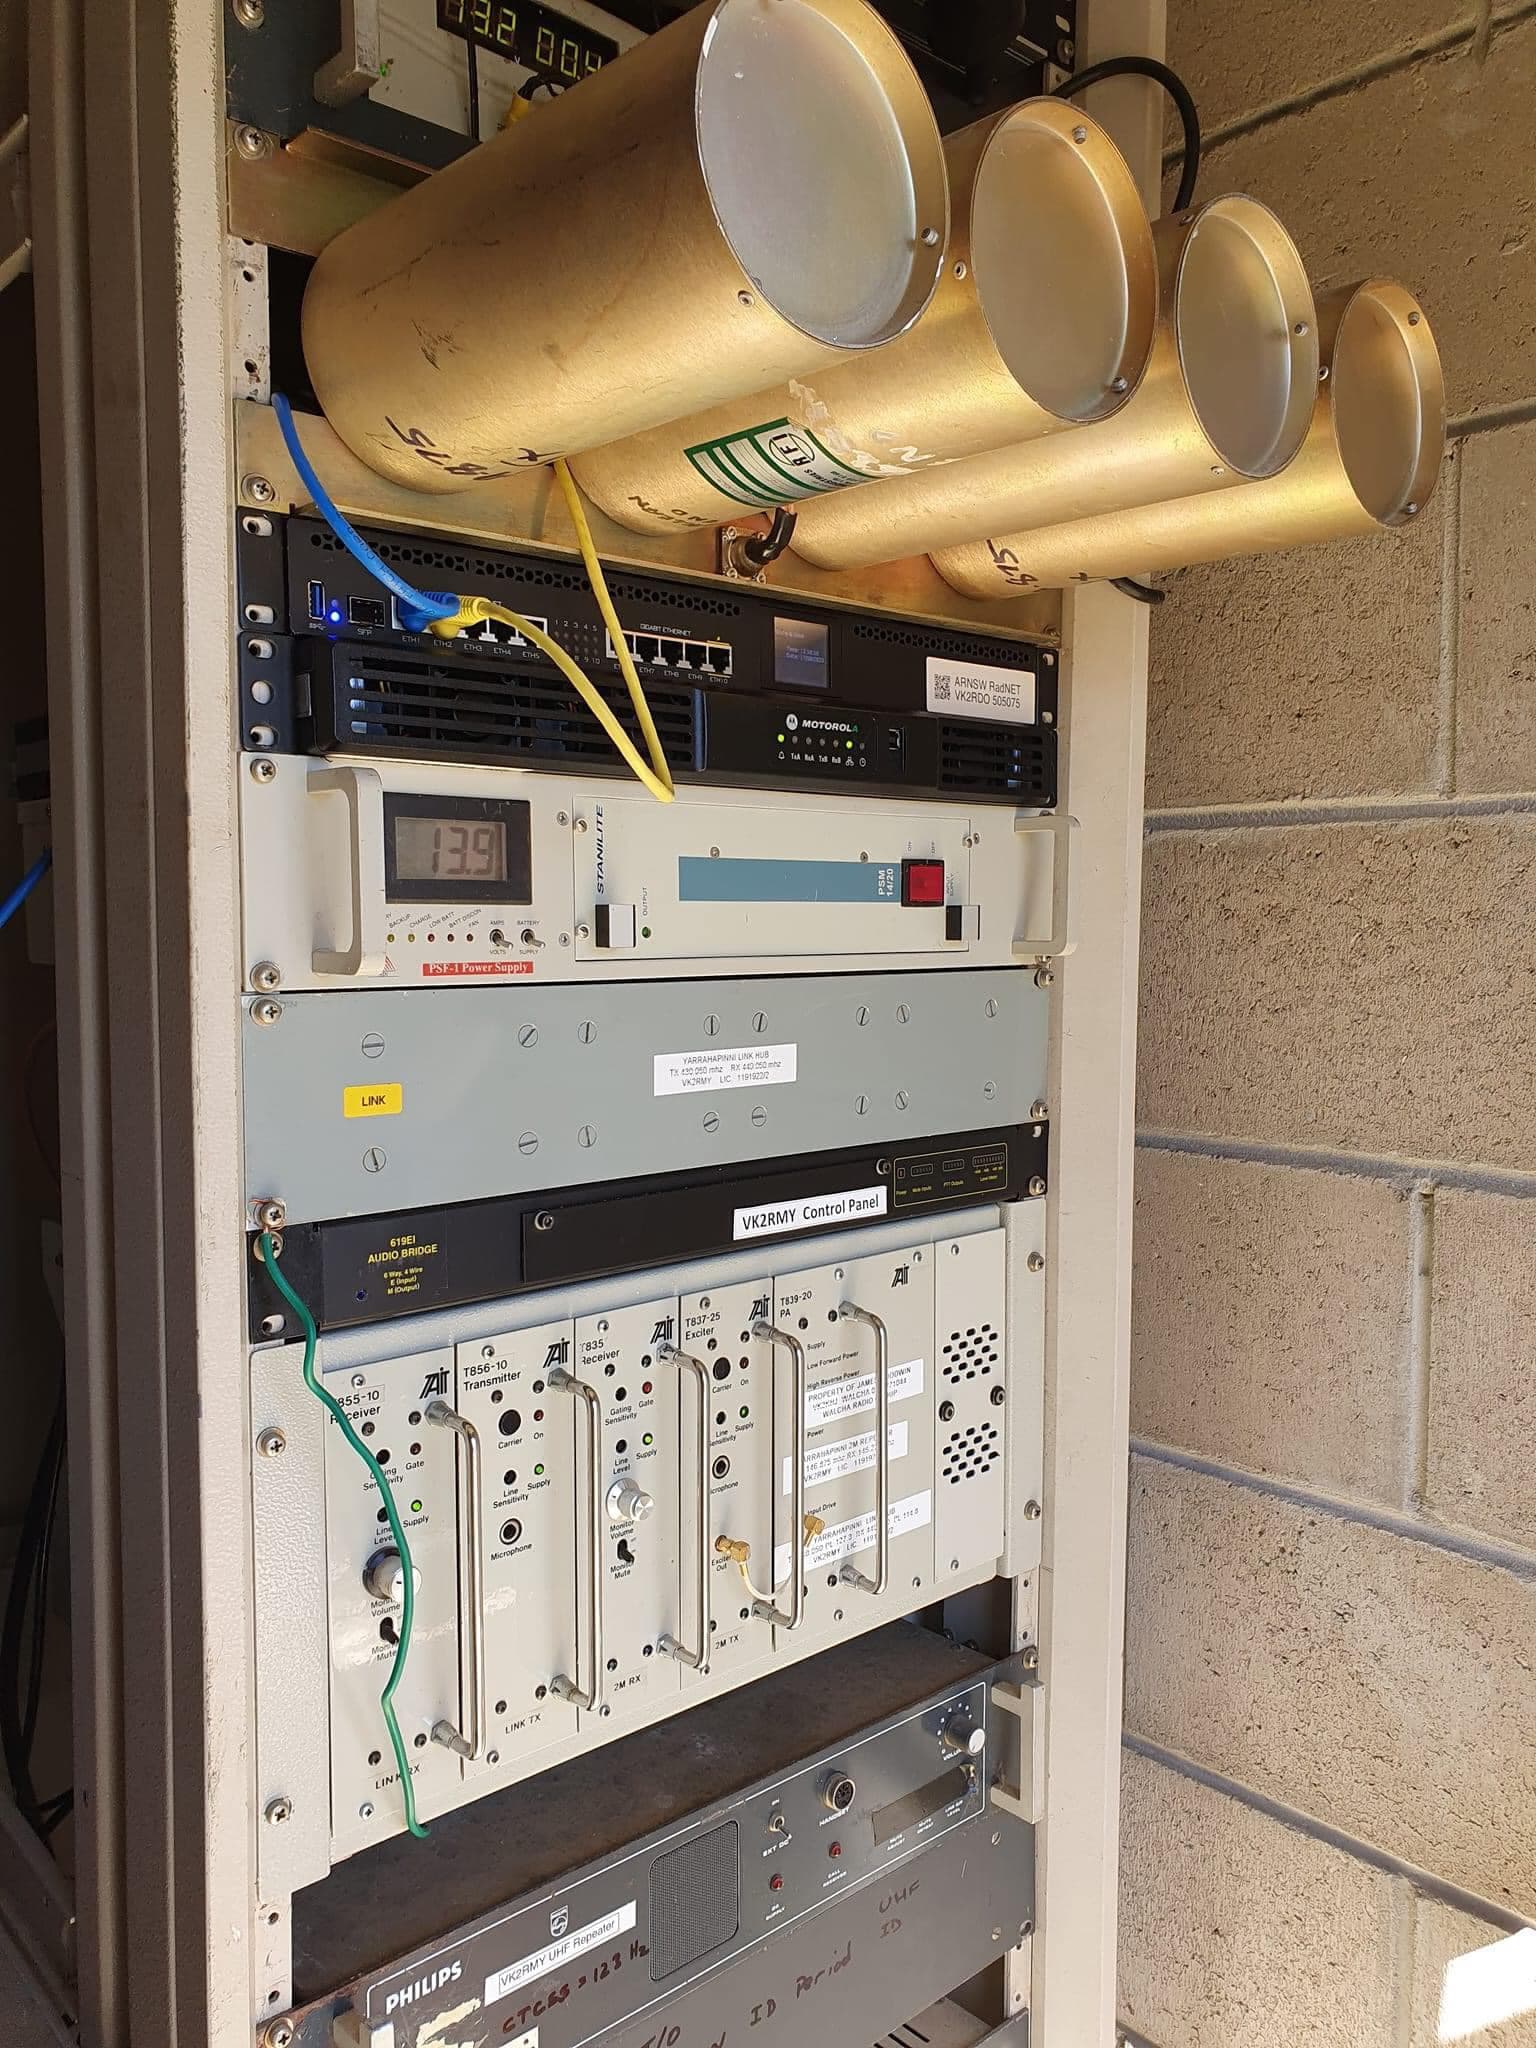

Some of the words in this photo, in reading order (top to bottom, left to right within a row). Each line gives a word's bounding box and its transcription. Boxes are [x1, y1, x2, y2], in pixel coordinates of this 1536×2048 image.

[771, 433, 811, 467] RFI
[662, 626, 692, 637] ETHERNET
[402, 635, 421, 645] ETH1
[433, 639, 453, 648] ETH2
[464, 643, 483, 652] ETH3
[494, 647, 512, 656] ETH4
[522, 651, 541, 660] ETH5
[640, 666, 656, 675] ETH7
[954, 676, 988, 691] ARNSW
[989, 681, 1021, 695] RadNET
[954, 689, 991, 706] VK2RDO
[992, 695, 1021, 709] 505075
[802, 719, 859, 733] MOTOROLA
[596, 804, 605, 895] STANILITE
[878, 869, 886, 896] PSM
[886, 868, 894, 897] 14/20
[388, 913, 412, 928] BACKUP
[410, 913, 433, 928] CHARGE
[440, 911, 456, 924] BATT
[468, 919, 480, 929] FAN
[489, 919, 505, 927] AMPS
[516, 919, 540, 927] BATTERY
[489, 949, 507, 957] VOLTS
[518, 949, 539, 958] SUPPLY
[462, 962, 493, 973] Power
[495, 961, 529, 975] Supply
[682, 1054, 737, 1065] YARRAHAPINNI
[738, 1052, 754, 1061] LINK
[754, 1050, 770, 1059] HUB
[669, 1069, 680, 1077] TX
[730, 1064, 741, 1072] RX
[681, 1076, 712, 1087] VK2RMY
[719, 1074, 731, 1083] LIC
[361, 1094, 386, 1107] LINK
[742, 1208, 796, 1231] VK2RMY
[802, 1203, 845, 1220] Control
[849, 1194, 879, 1214] Panel
[367, 1249, 399, 1264] AUDIO
[401, 1243, 438, 1258] BRIDGE
[409, 1266, 423, 1275] Wire
[780, 1290, 813, 1307] T839-20
[684, 1311, 721, 1328] T837-25
[780, 1308, 792, 1318] PA
[685, 1326, 714, 1341] Exciter
[580, 1338, 604, 1352] T835
[806, 1340, 826, 1351] Supply
[806, 1362, 819, 1370] Low
[820, 1354, 842, 1366] Forward
[843, 1351, 860, 1360] Power
[463, 1359, 509, 1378] T856-10
[463, 1370, 522, 1392] Transmitter
[740, 1378, 750, 1386] On
[806, 1381, 820, 1390] High
[821, 1375, 842, 1385] Reverse
[843, 1369, 861, 1379] Power
[712, 1383, 733, 1395] Carrier
[808, 1386, 845, 1403] PROPERTY
[845, 1381, 855, 1392] OF
[337, 1389, 381, 1408] 855-10
[638, 1399, 654, 1408] Gate
[610, 1404, 633, 1417] Gating
[822, 1402, 851, 1418] WALCHA
[852, 1396, 874, 1409] RADIO
[604, 1411, 638, 1427] Sensitivity
[734, 1420, 755, 1432] Supply
[533, 1432, 544, 1440] On
[715, 1427, 729, 1438] Line
[806, 1428, 824, 1440] Power
[498, 1438, 523, 1450] Carrier
[614, 1456, 629, 1467] Line
[636, 1448, 658, 1461] Supply
[405, 1459, 425, 1471] Gate
[613, 1464, 631, 1476] Level
[527, 1477, 552, 1491] Supply
[503, 1488, 519, 1498] Line
[492, 1493, 529, 1509] Sensitivity
[807, 1506, 822, 1516] Input
[822, 1501, 838, 1512] Drive
[402, 1514, 430, 1529] Supply
[609, 1519, 635, 1533] Monitor
[610, 1527, 635, 1541] Volume
[490, 1542, 533, 1561] Microphone
[613, 1568, 631, 1580] Mute
[715, 1563, 728, 1573] Out
[371, 1602, 401, 1618] Volume
[714, 1638, 727, 1650] 2M
[729, 1633, 740, 1644] TX
[376, 1649, 397, 1662] Mute
[613, 1680, 626, 1692] 2M
[628, 1674, 642, 1686] RX
[505, 1719, 527, 1735] LINK
[529, 1712, 542, 1725] TX
[819, 1806, 850, 1827] HANDSET
[762, 1845, 778, 1857] EXT
[778, 1839, 790, 1849] DC
[878, 1879, 920, 1914] UHF
[878, 1917, 903, 1940] ID
[500, 1954, 547, 1987] VK2RMY
[548, 1943, 571, 1962] UHF
[573, 1920, 616, 1950] Repeater
[385, 1959, 463, 2016] PHILIPS
[750, 1998, 777, 2027] ID
[795, 1939, 852, 2000] Period
